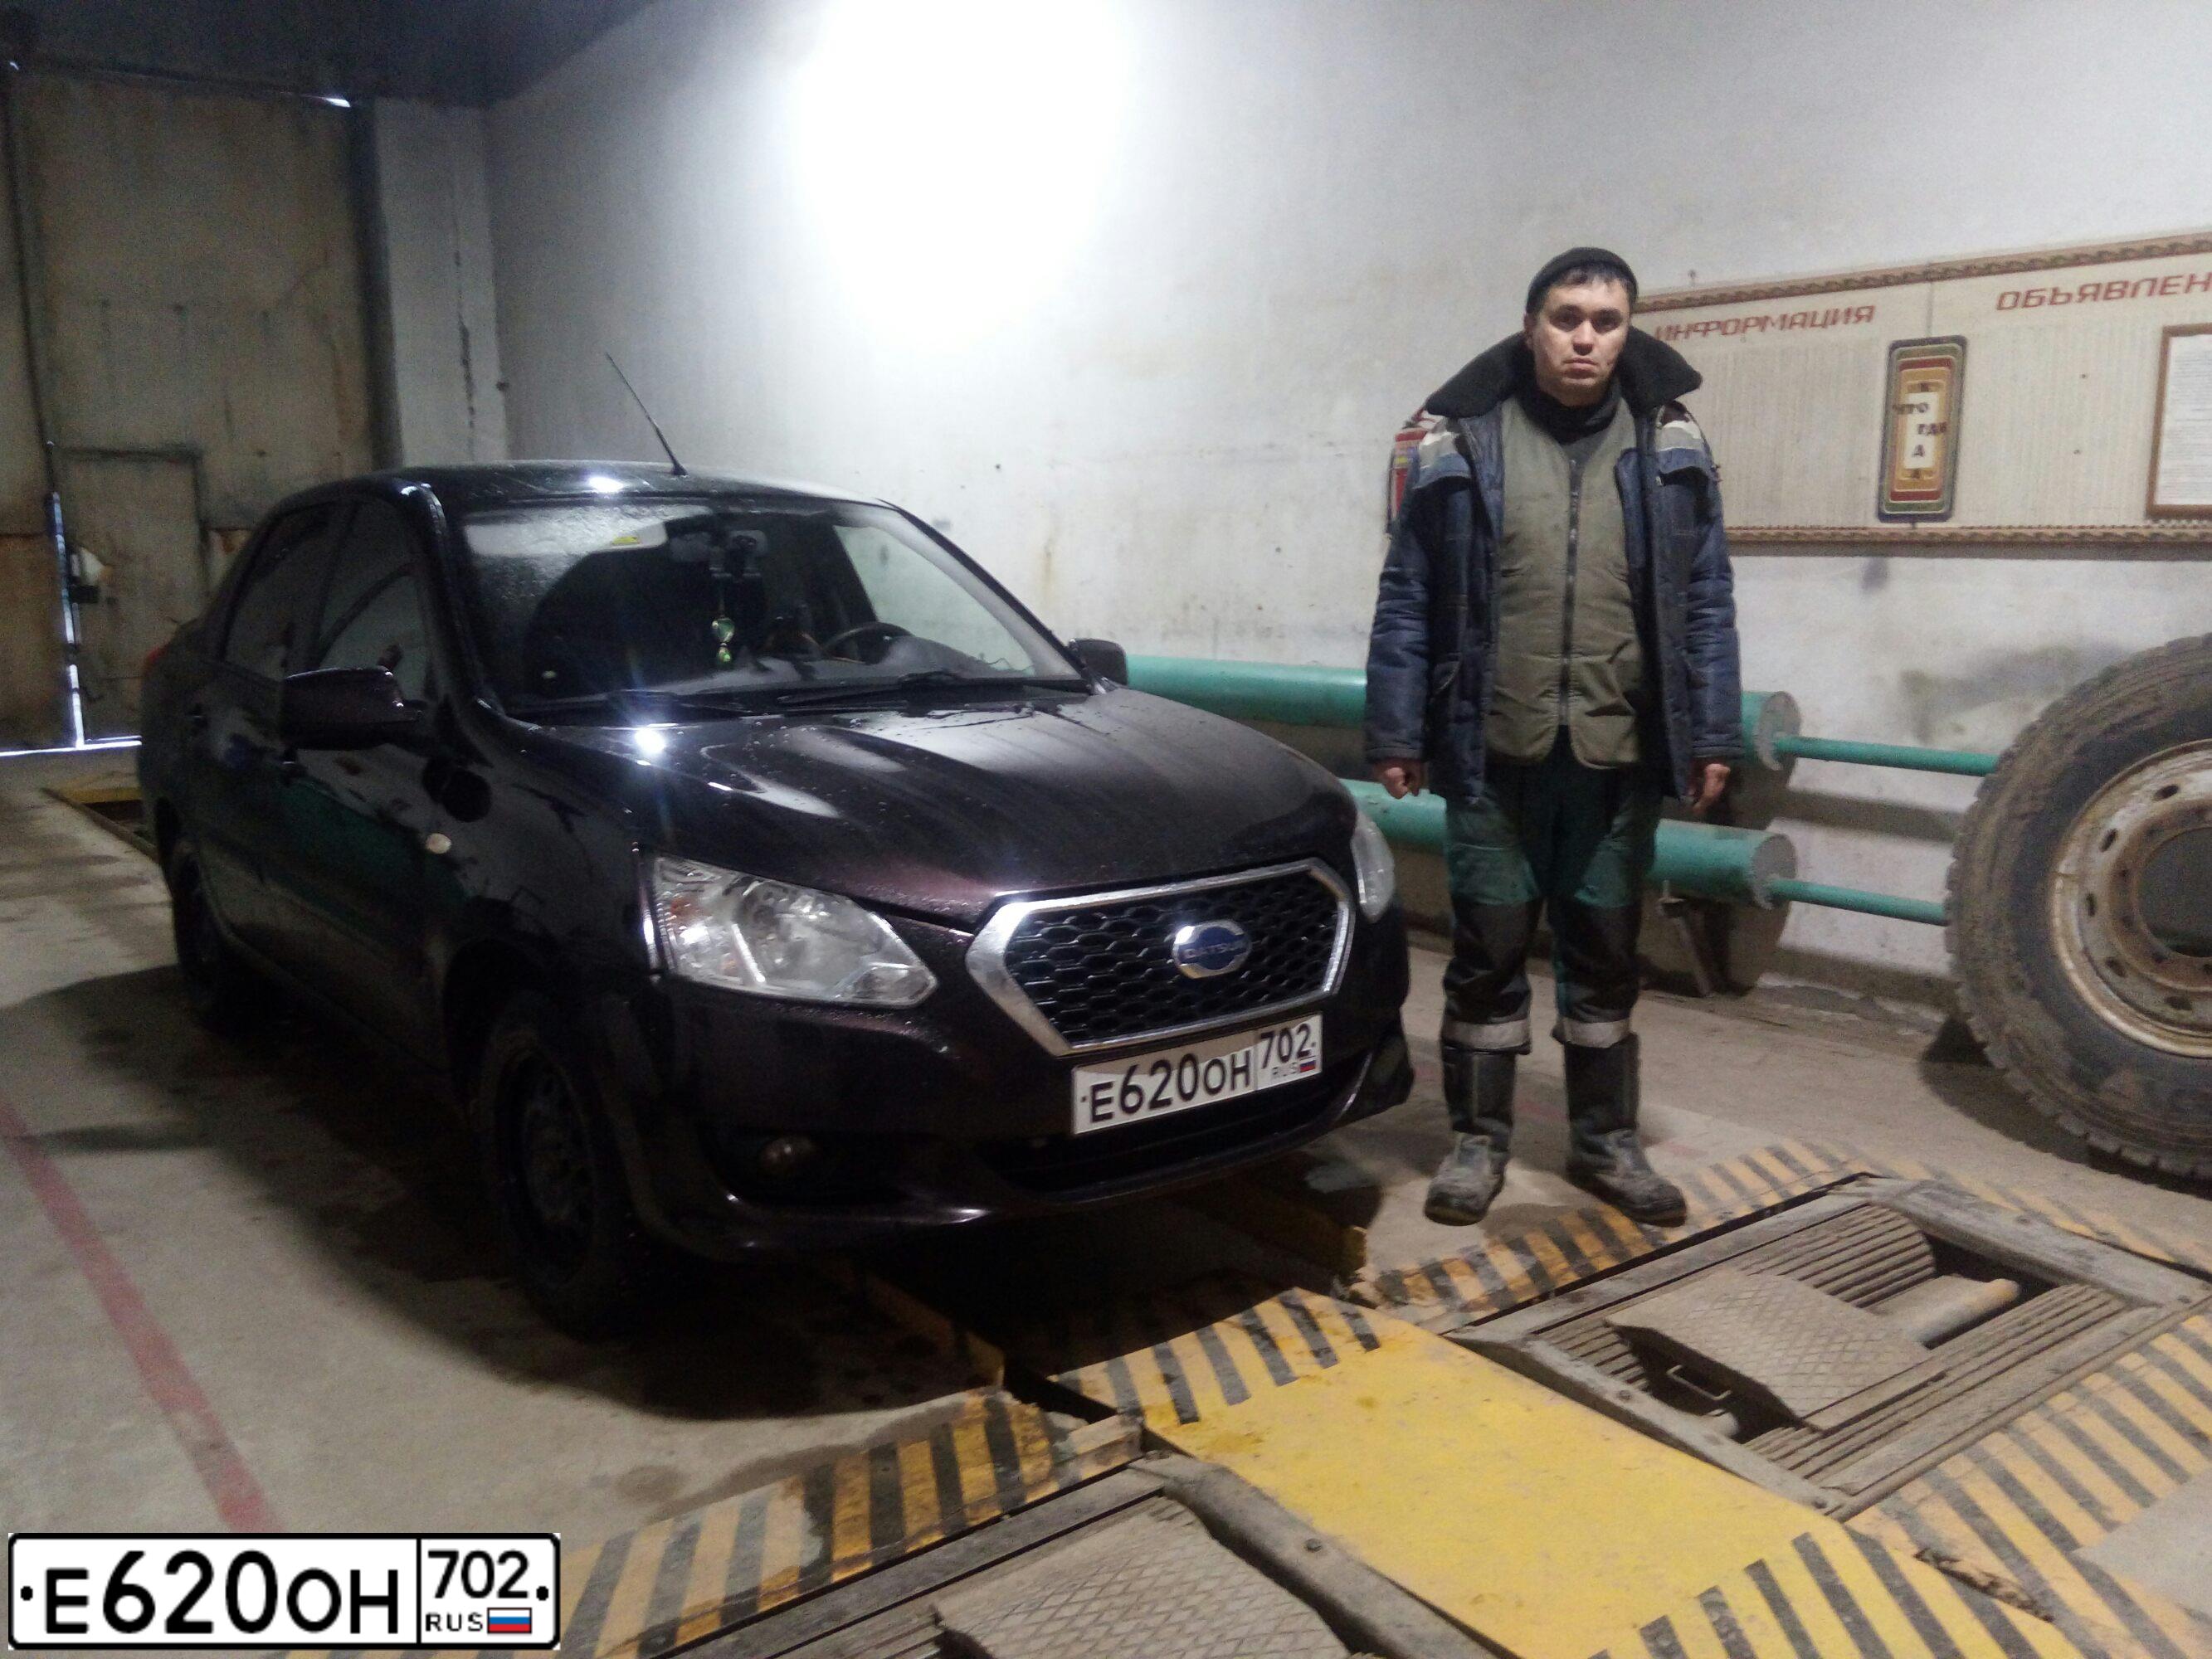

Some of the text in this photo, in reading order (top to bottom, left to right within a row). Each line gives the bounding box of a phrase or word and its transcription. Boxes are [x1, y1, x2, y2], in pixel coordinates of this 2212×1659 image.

[1654, 304, 1876, 341] ИНФОРМАЦИЯ
[1090, 1023, 1311, 1123] Е620ОН 702
